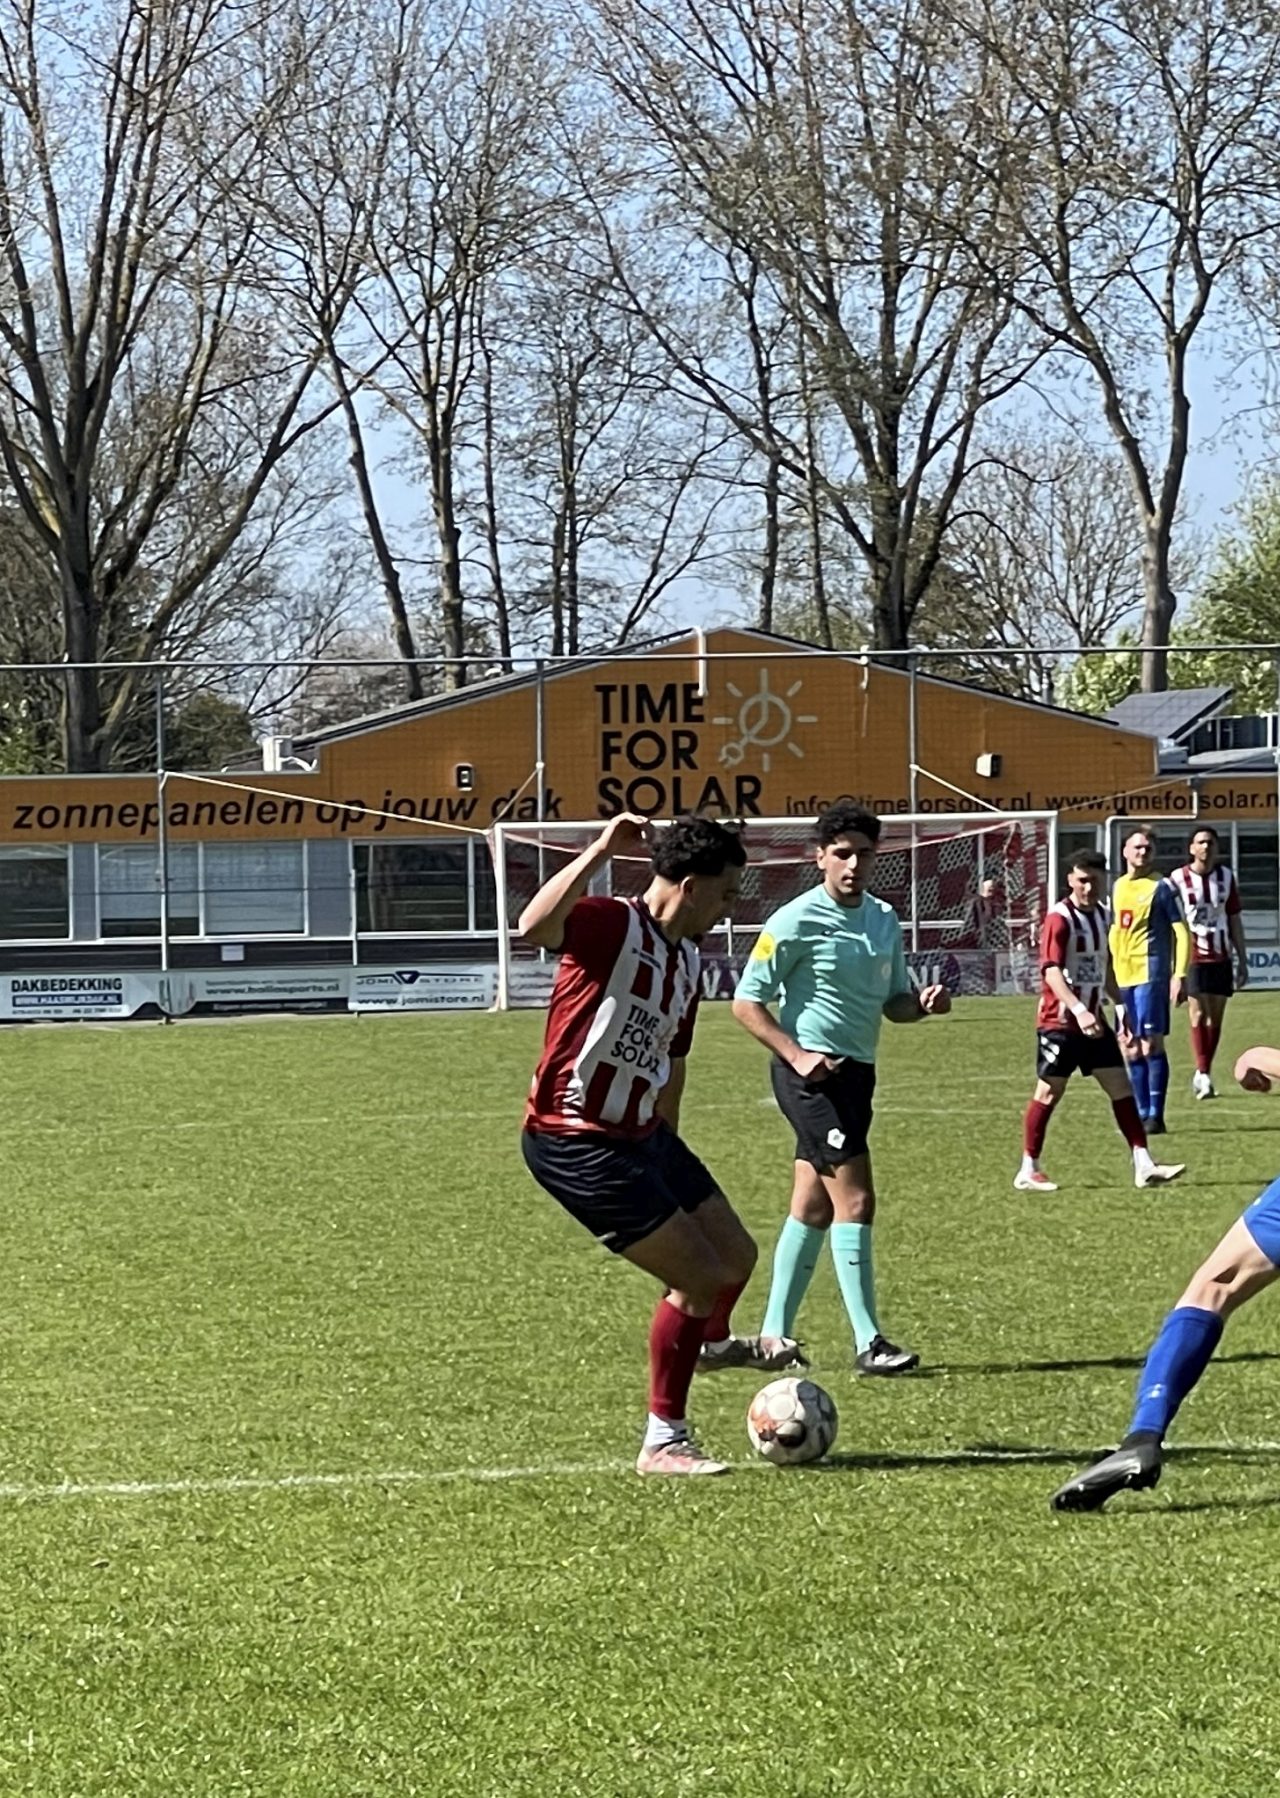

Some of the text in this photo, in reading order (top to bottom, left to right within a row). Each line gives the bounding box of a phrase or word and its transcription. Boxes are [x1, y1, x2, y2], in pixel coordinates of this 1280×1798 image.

[594, 683, 705, 724] TIME
[601, 729, 699, 772] FOR
[13, 788, 562, 835] zonnepanelen op jouw dak
[597, 775, 762, 818] SOLAR
[1045, 790, 1279, 811] www.timeforsolar.n
[11, 978, 122, 992] DAKBEDEKKING
